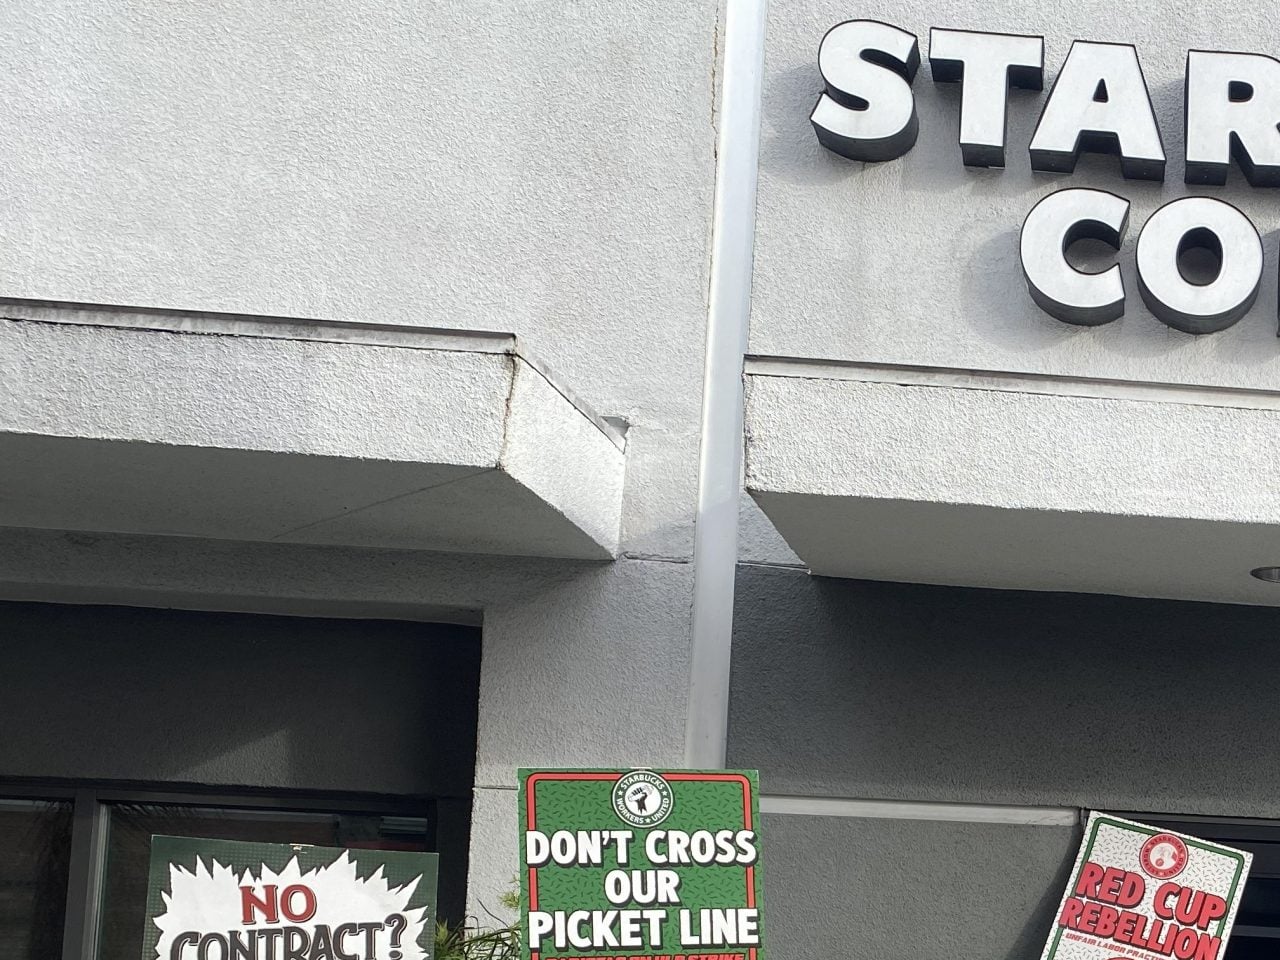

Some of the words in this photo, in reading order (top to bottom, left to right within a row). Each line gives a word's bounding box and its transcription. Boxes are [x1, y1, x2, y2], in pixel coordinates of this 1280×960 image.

[621, 774, 665, 790] STARBUCKS
[617, 798, 644, 823] WORKERS
[652, 798, 669, 821] UNITED
[525, 830, 633, 865] DON'T
[645, 829, 756, 865] CROSS
[604, 870, 681, 904] OUR
[1075, 862, 1146, 908] RED
[1154, 882, 1227, 931] CUP
[239, 884, 317, 925] NO
[528, 909, 666, 949] PICKET
[679, 908, 760, 947] LINE
[1065, 932, 1096, 946] UNFAIR
[1097, 941, 1125, 954] LABOR
